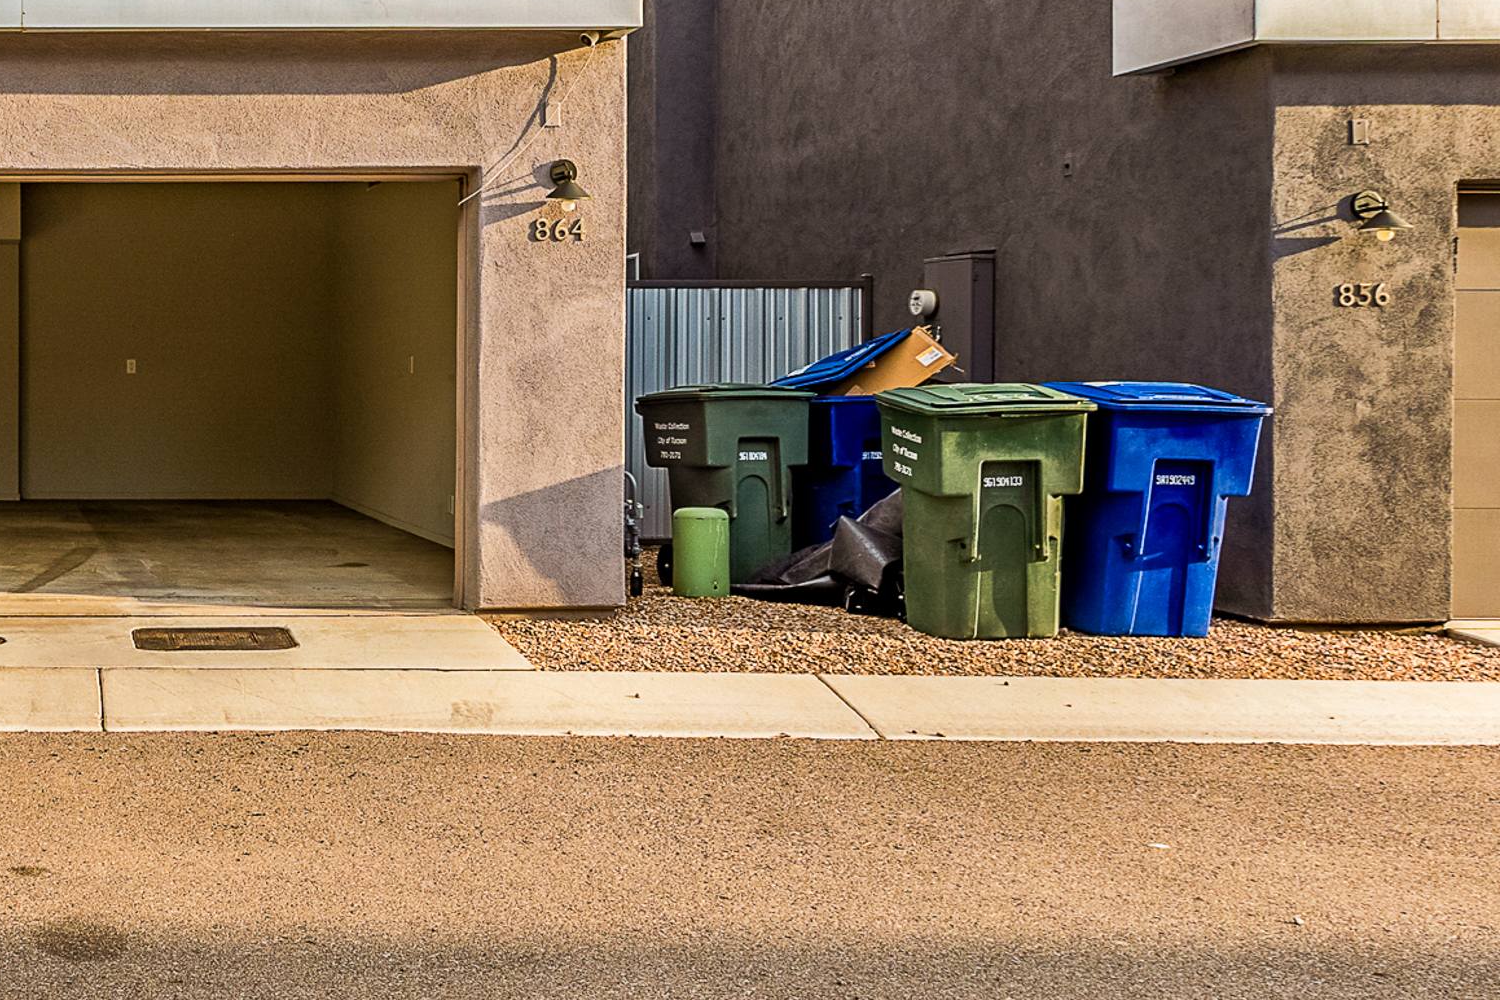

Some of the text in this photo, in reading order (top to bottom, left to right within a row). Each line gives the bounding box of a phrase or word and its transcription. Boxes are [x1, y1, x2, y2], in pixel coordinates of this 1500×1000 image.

[535, 218, 586, 241] 864
[1339, 283, 1390, 306] 856
[668, 422, 690, 430] Collection
